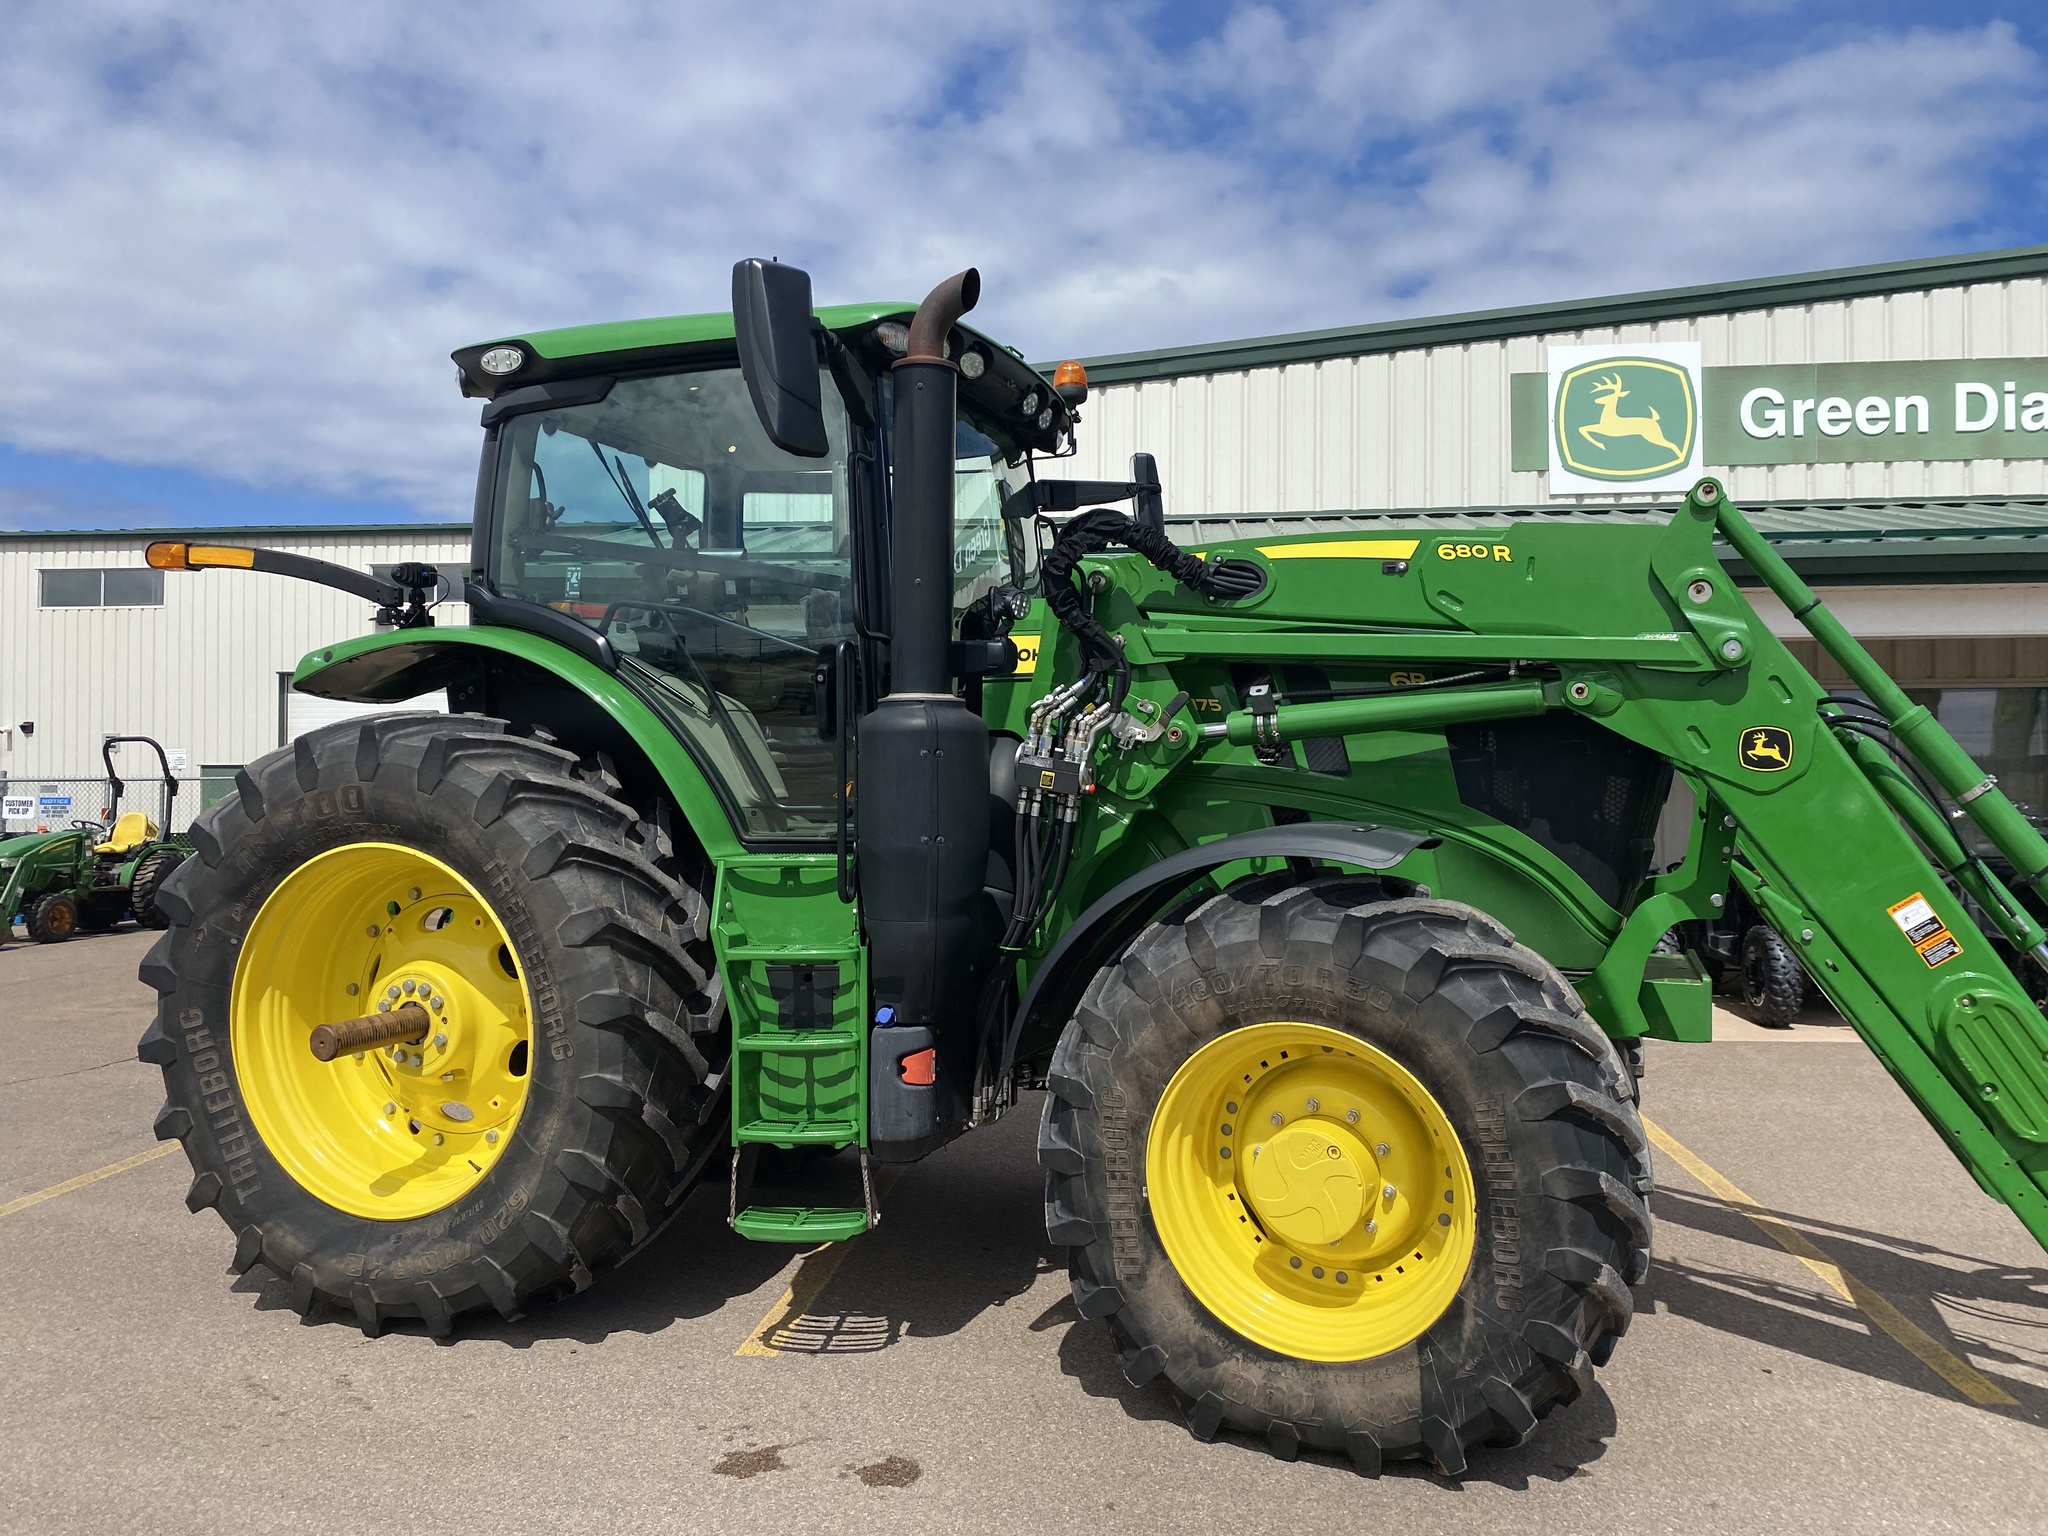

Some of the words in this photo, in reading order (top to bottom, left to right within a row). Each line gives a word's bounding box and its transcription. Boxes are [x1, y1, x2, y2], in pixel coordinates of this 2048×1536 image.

[1740, 387, 1930, 439] Green
[1955, 381, 2048, 433] Dia
[1437, 543, 1489, 561] 680
[1492, 544, 1514, 562] R
[1018, 648, 1038, 662] OH
[5, 799, 34, 807] CUSTOMER
[284, 785, 366, 829] 700
[482, 847, 575, 1062] TRELLEBORG
[1227, 997, 1274, 1016] BLUE
[179, 1007, 262, 1206] TRELLEBORG
[1100, 1084, 1142, 1281] TRELLEBORG
[1474, 1092, 1528, 1312] TRELLEBORG
